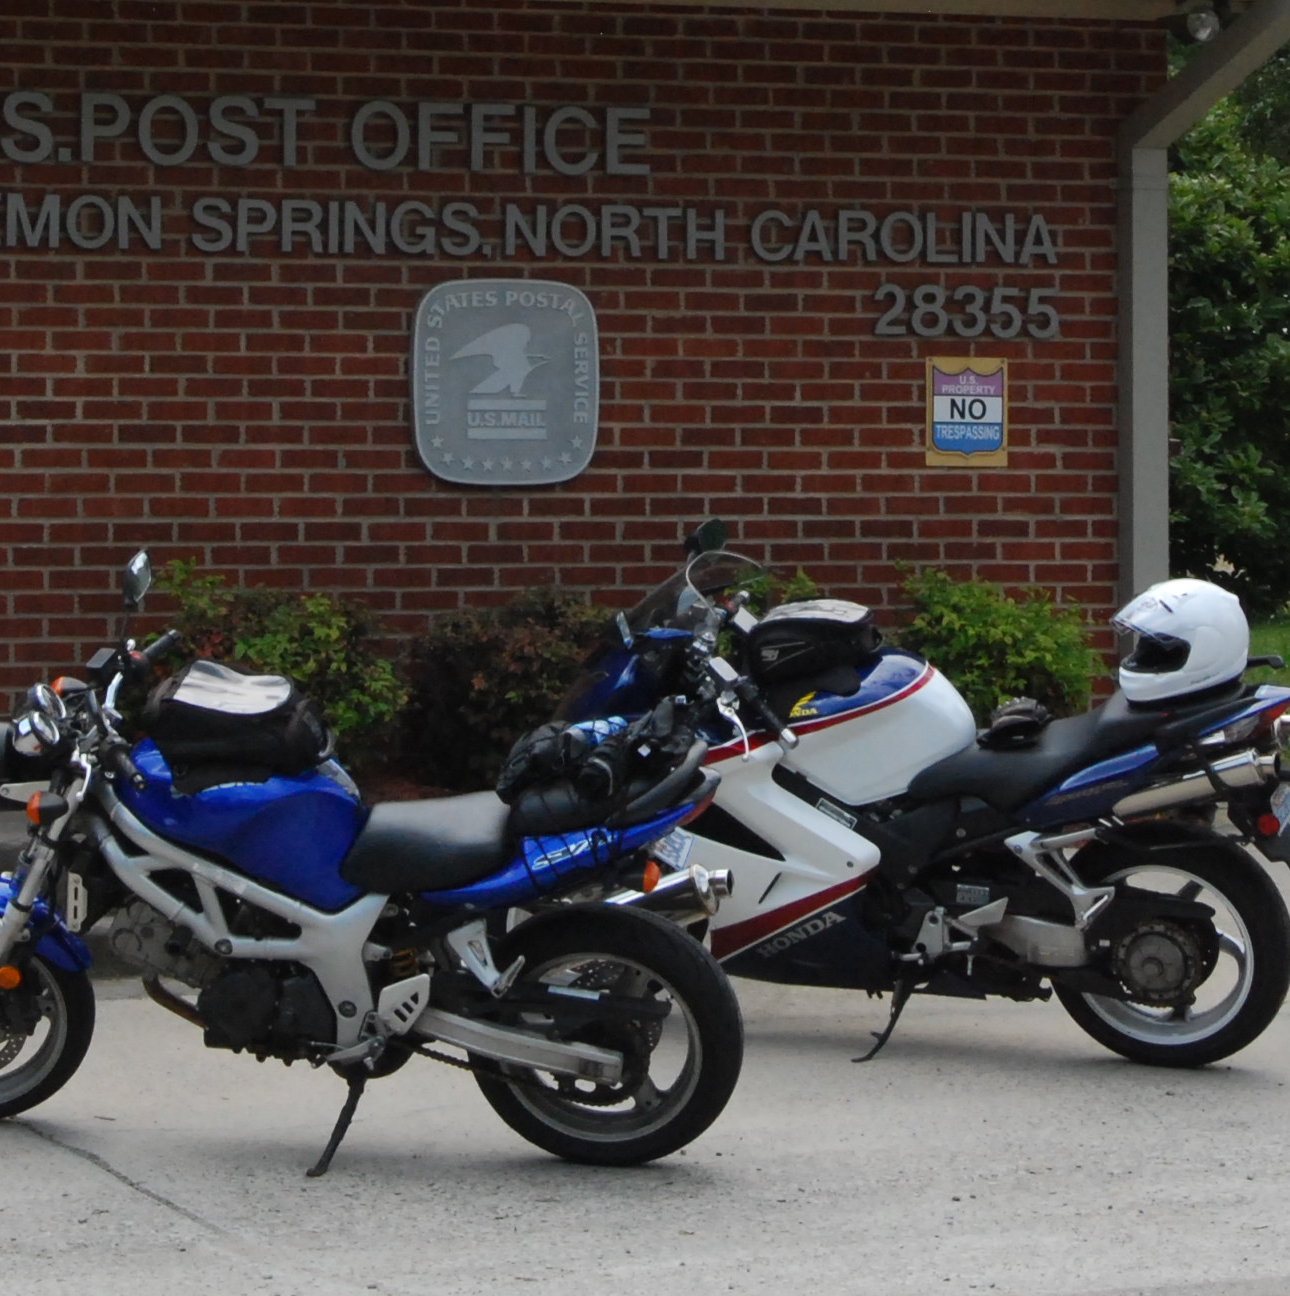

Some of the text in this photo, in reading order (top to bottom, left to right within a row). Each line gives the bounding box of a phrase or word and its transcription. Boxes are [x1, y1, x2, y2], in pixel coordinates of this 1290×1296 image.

[351, 101, 651, 175] OFFICE
[750, 208, 1058, 265] CAROLINA
[873, 283, 1059, 339] 28355
[425, 291, 590, 425] UNITED STATES POSTAL SERVICE
[959, 375, 979, 385] U.S.
[941, 384, 996, 395] PROPERTY
[950, 398, 987, 421] NO
[935, 425, 1000, 440] TRESPASSING
[756, 911, 847, 958] HONDA
